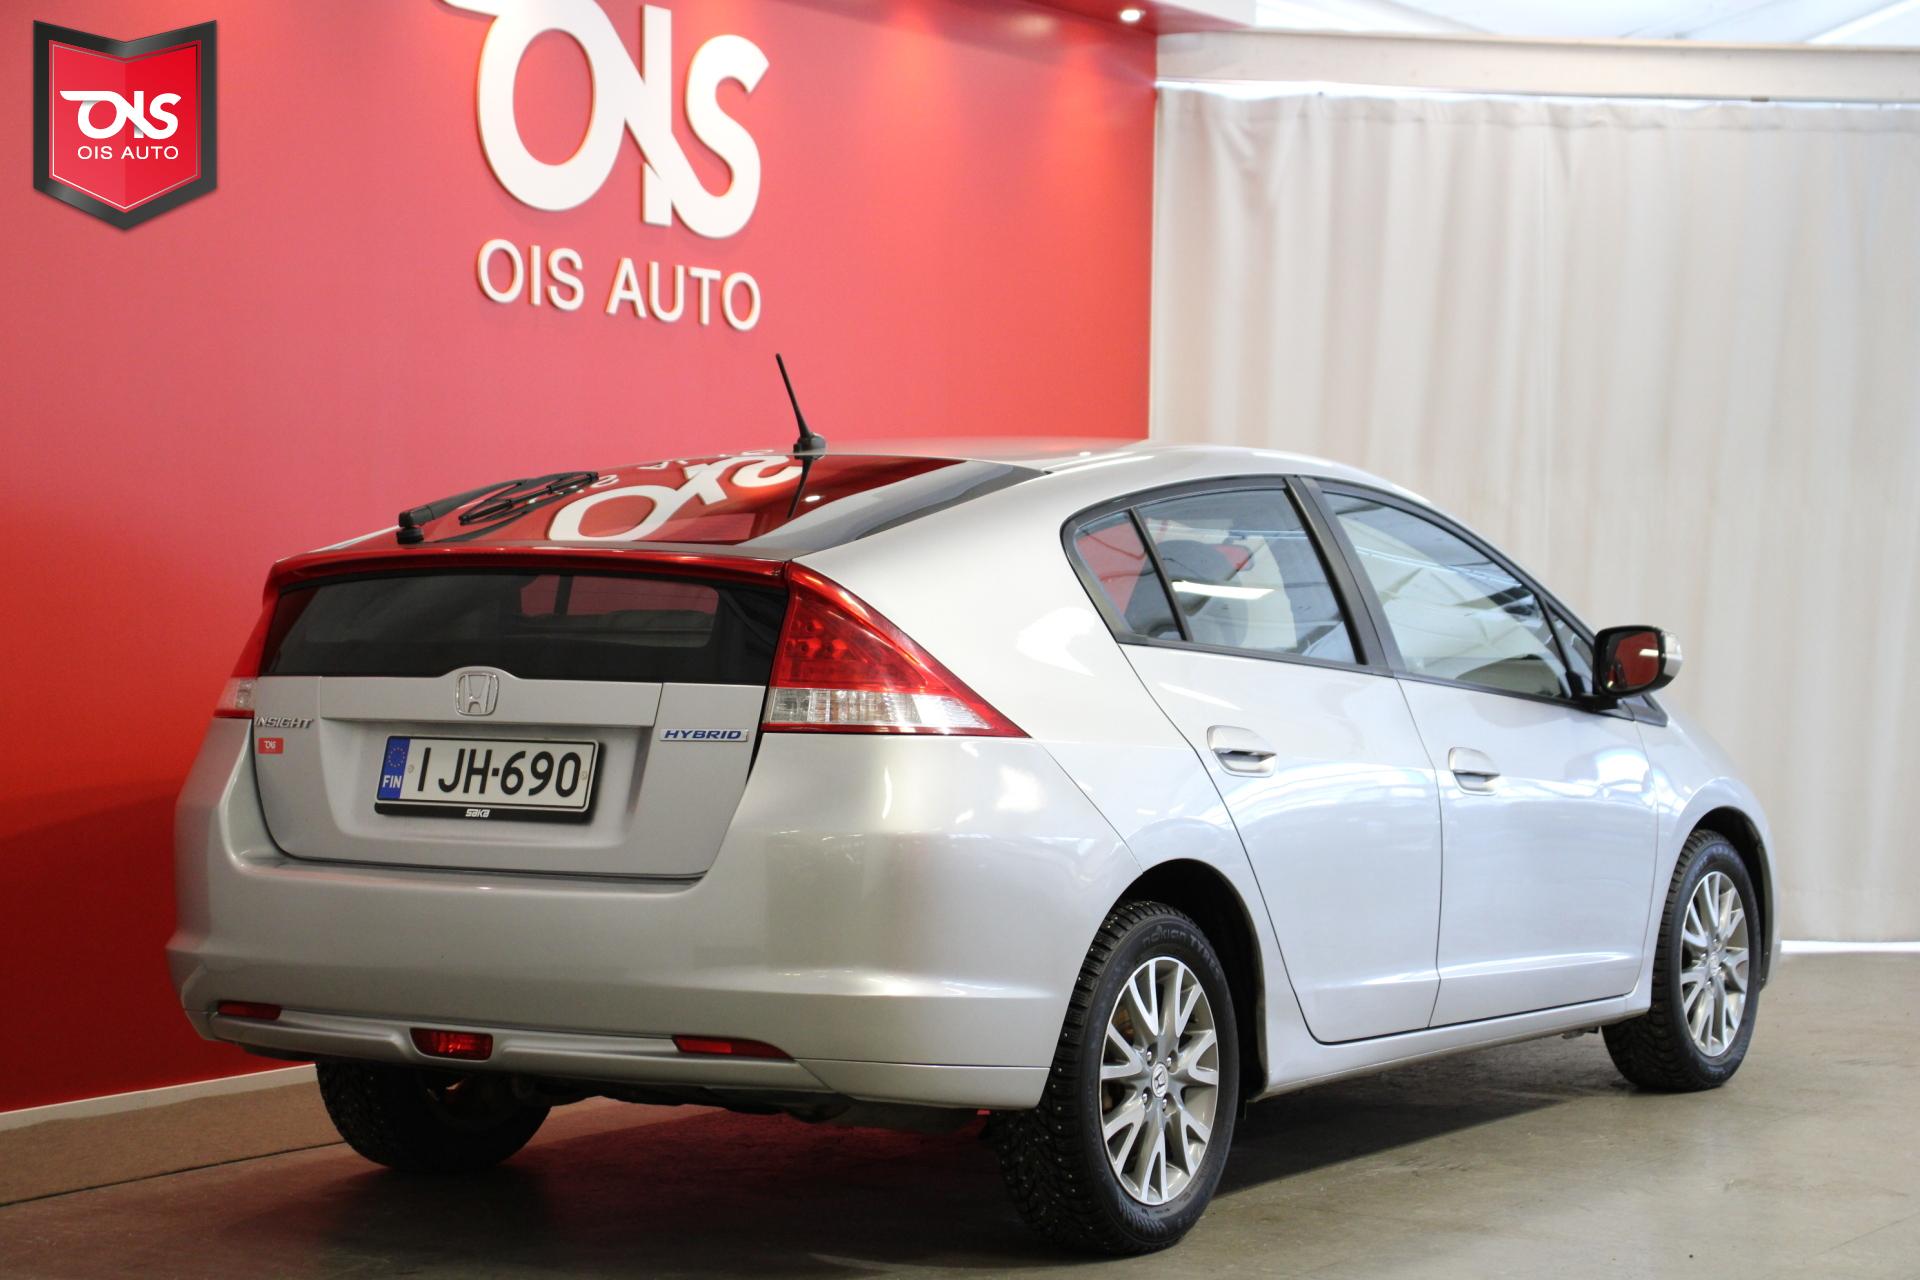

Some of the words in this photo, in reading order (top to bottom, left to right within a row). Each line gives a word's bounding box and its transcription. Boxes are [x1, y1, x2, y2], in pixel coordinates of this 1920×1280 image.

[441, 0, 770, 239] OIS
[477, 239, 585, 311] OIS
[605, 257, 761, 331] AUTO
[254, 716, 314, 729] INSIGHT
[664, 730, 742, 740] HYBRID
[382, 774, 401, 788] FIN
[417, 747, 582, 798] IJH-690
